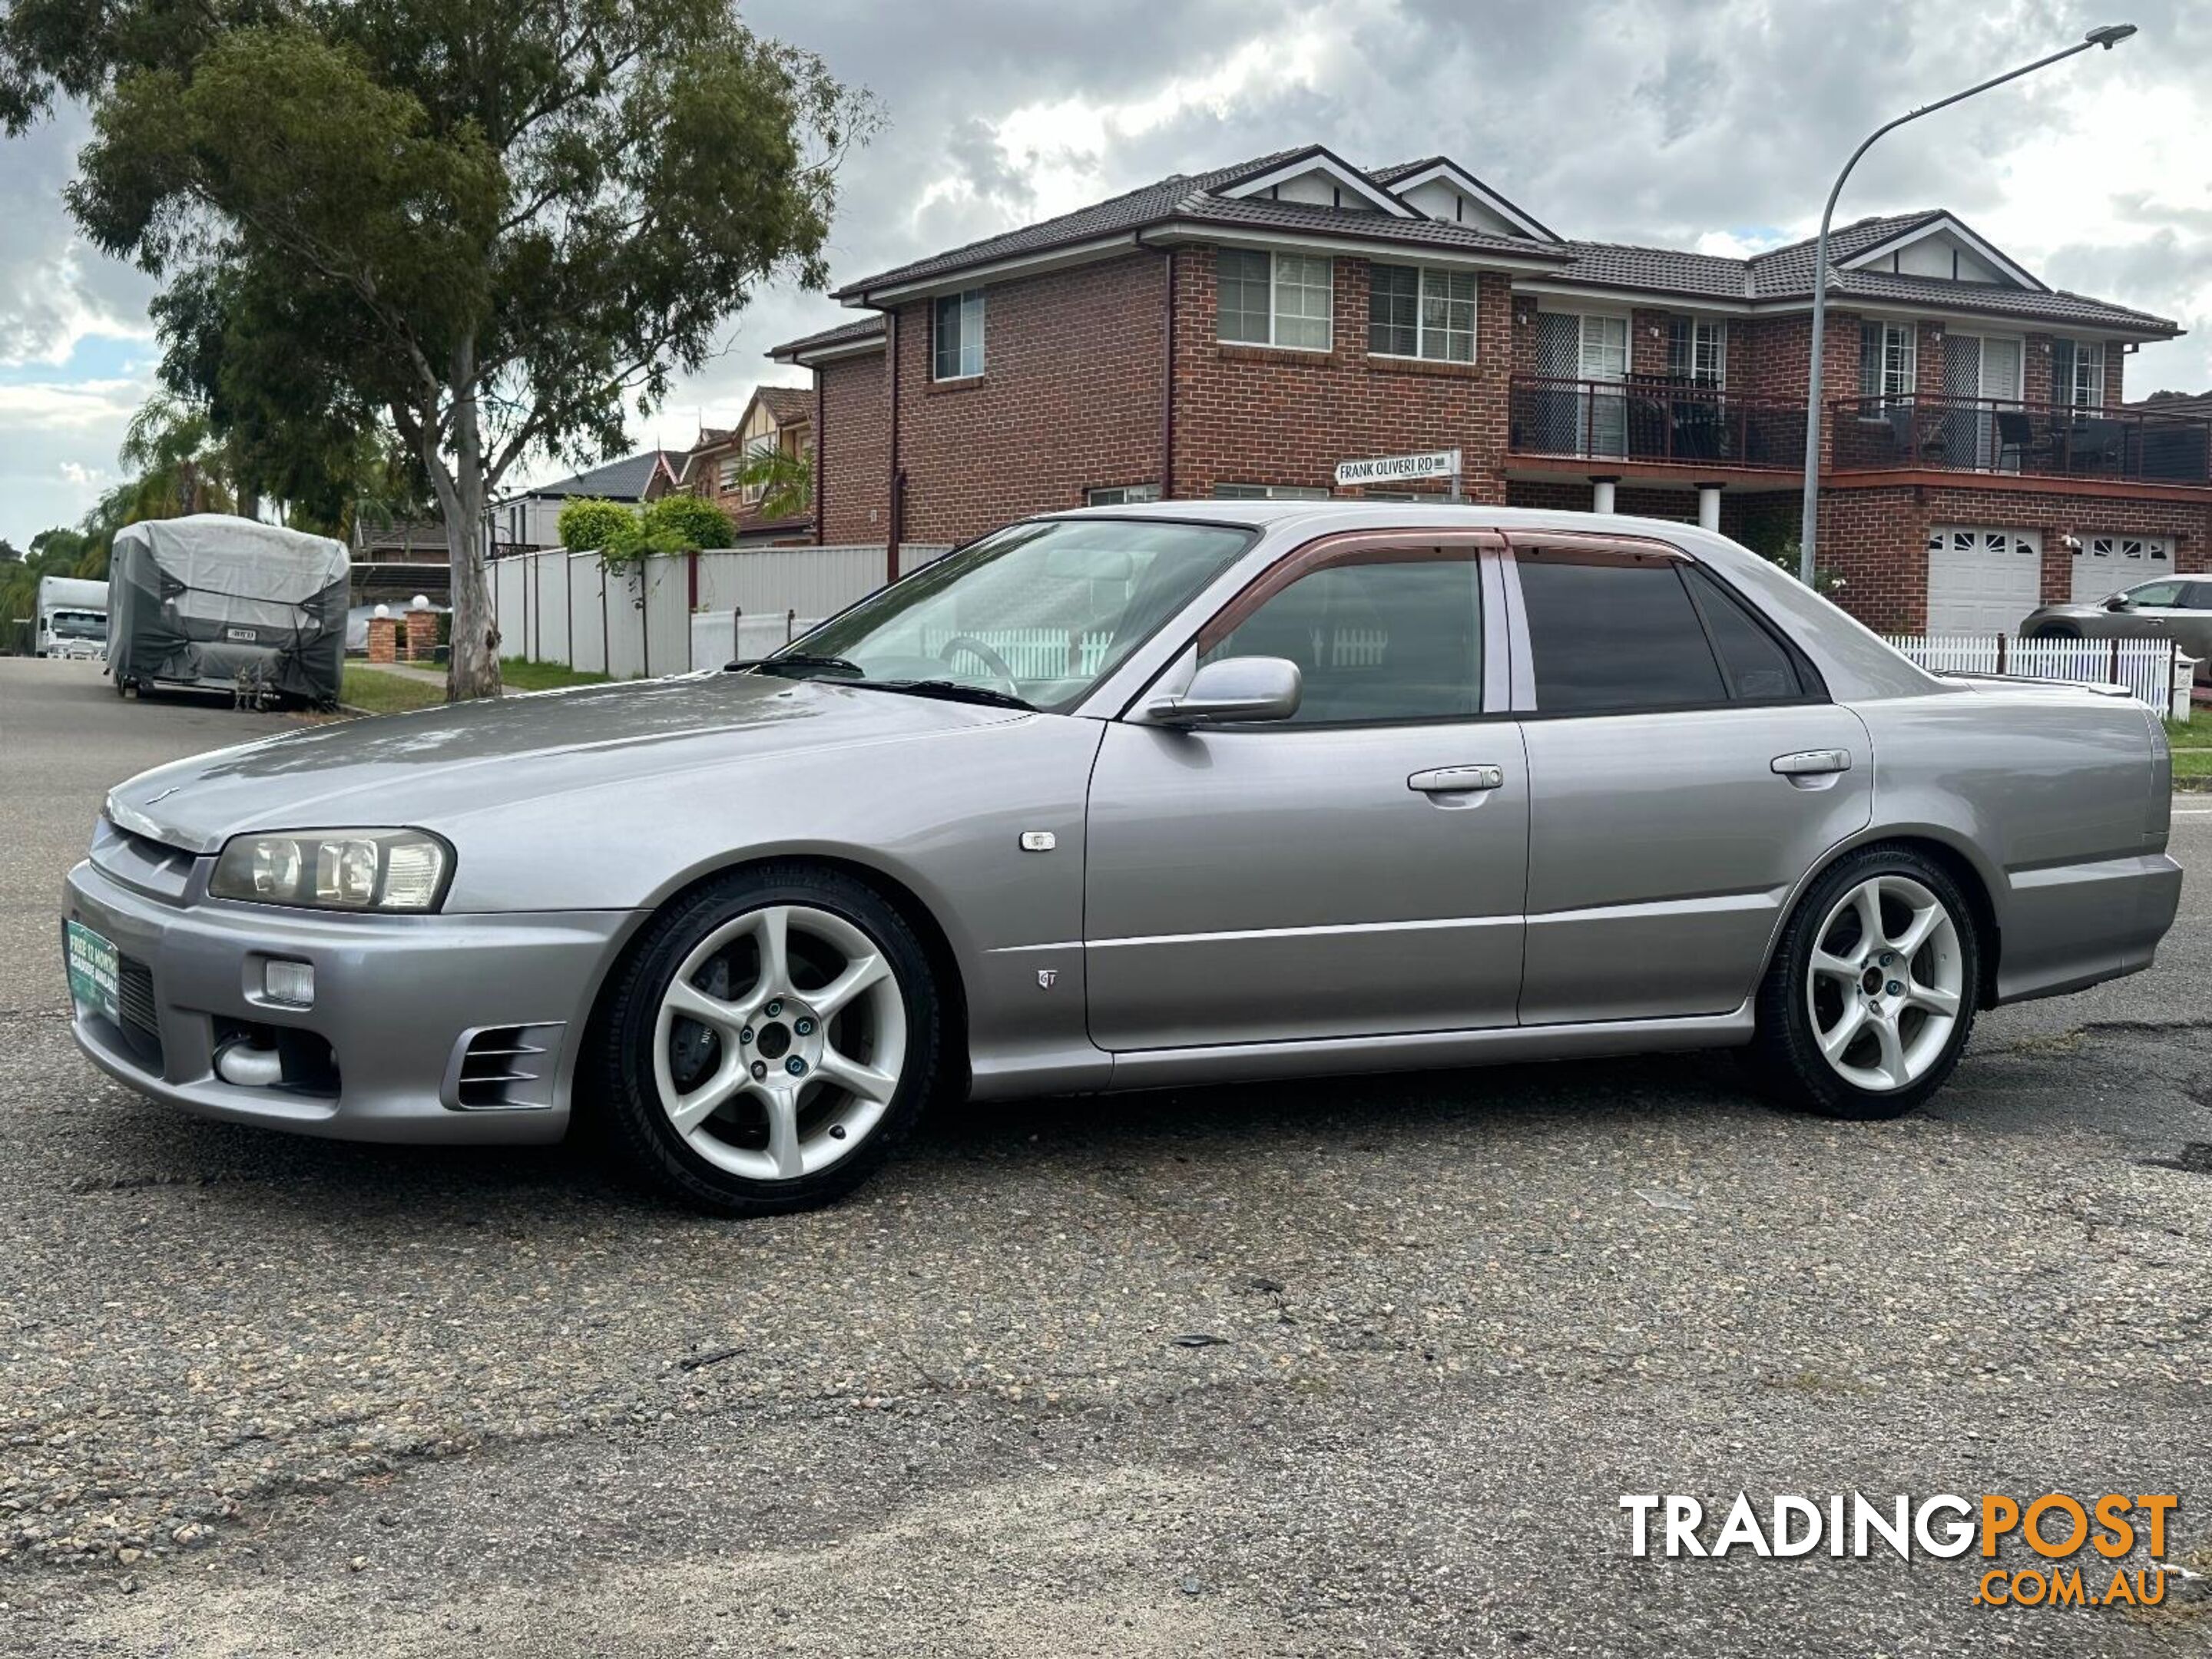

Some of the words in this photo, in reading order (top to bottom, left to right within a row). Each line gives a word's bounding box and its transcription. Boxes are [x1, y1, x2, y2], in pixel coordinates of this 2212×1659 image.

[1340, 462, 1374, 479] FRANK
[1376, 459, 1415, 475] OLIVERI
[1418, 457, 1432, 471] RD
[1039, 971, 1057, 987] GT
